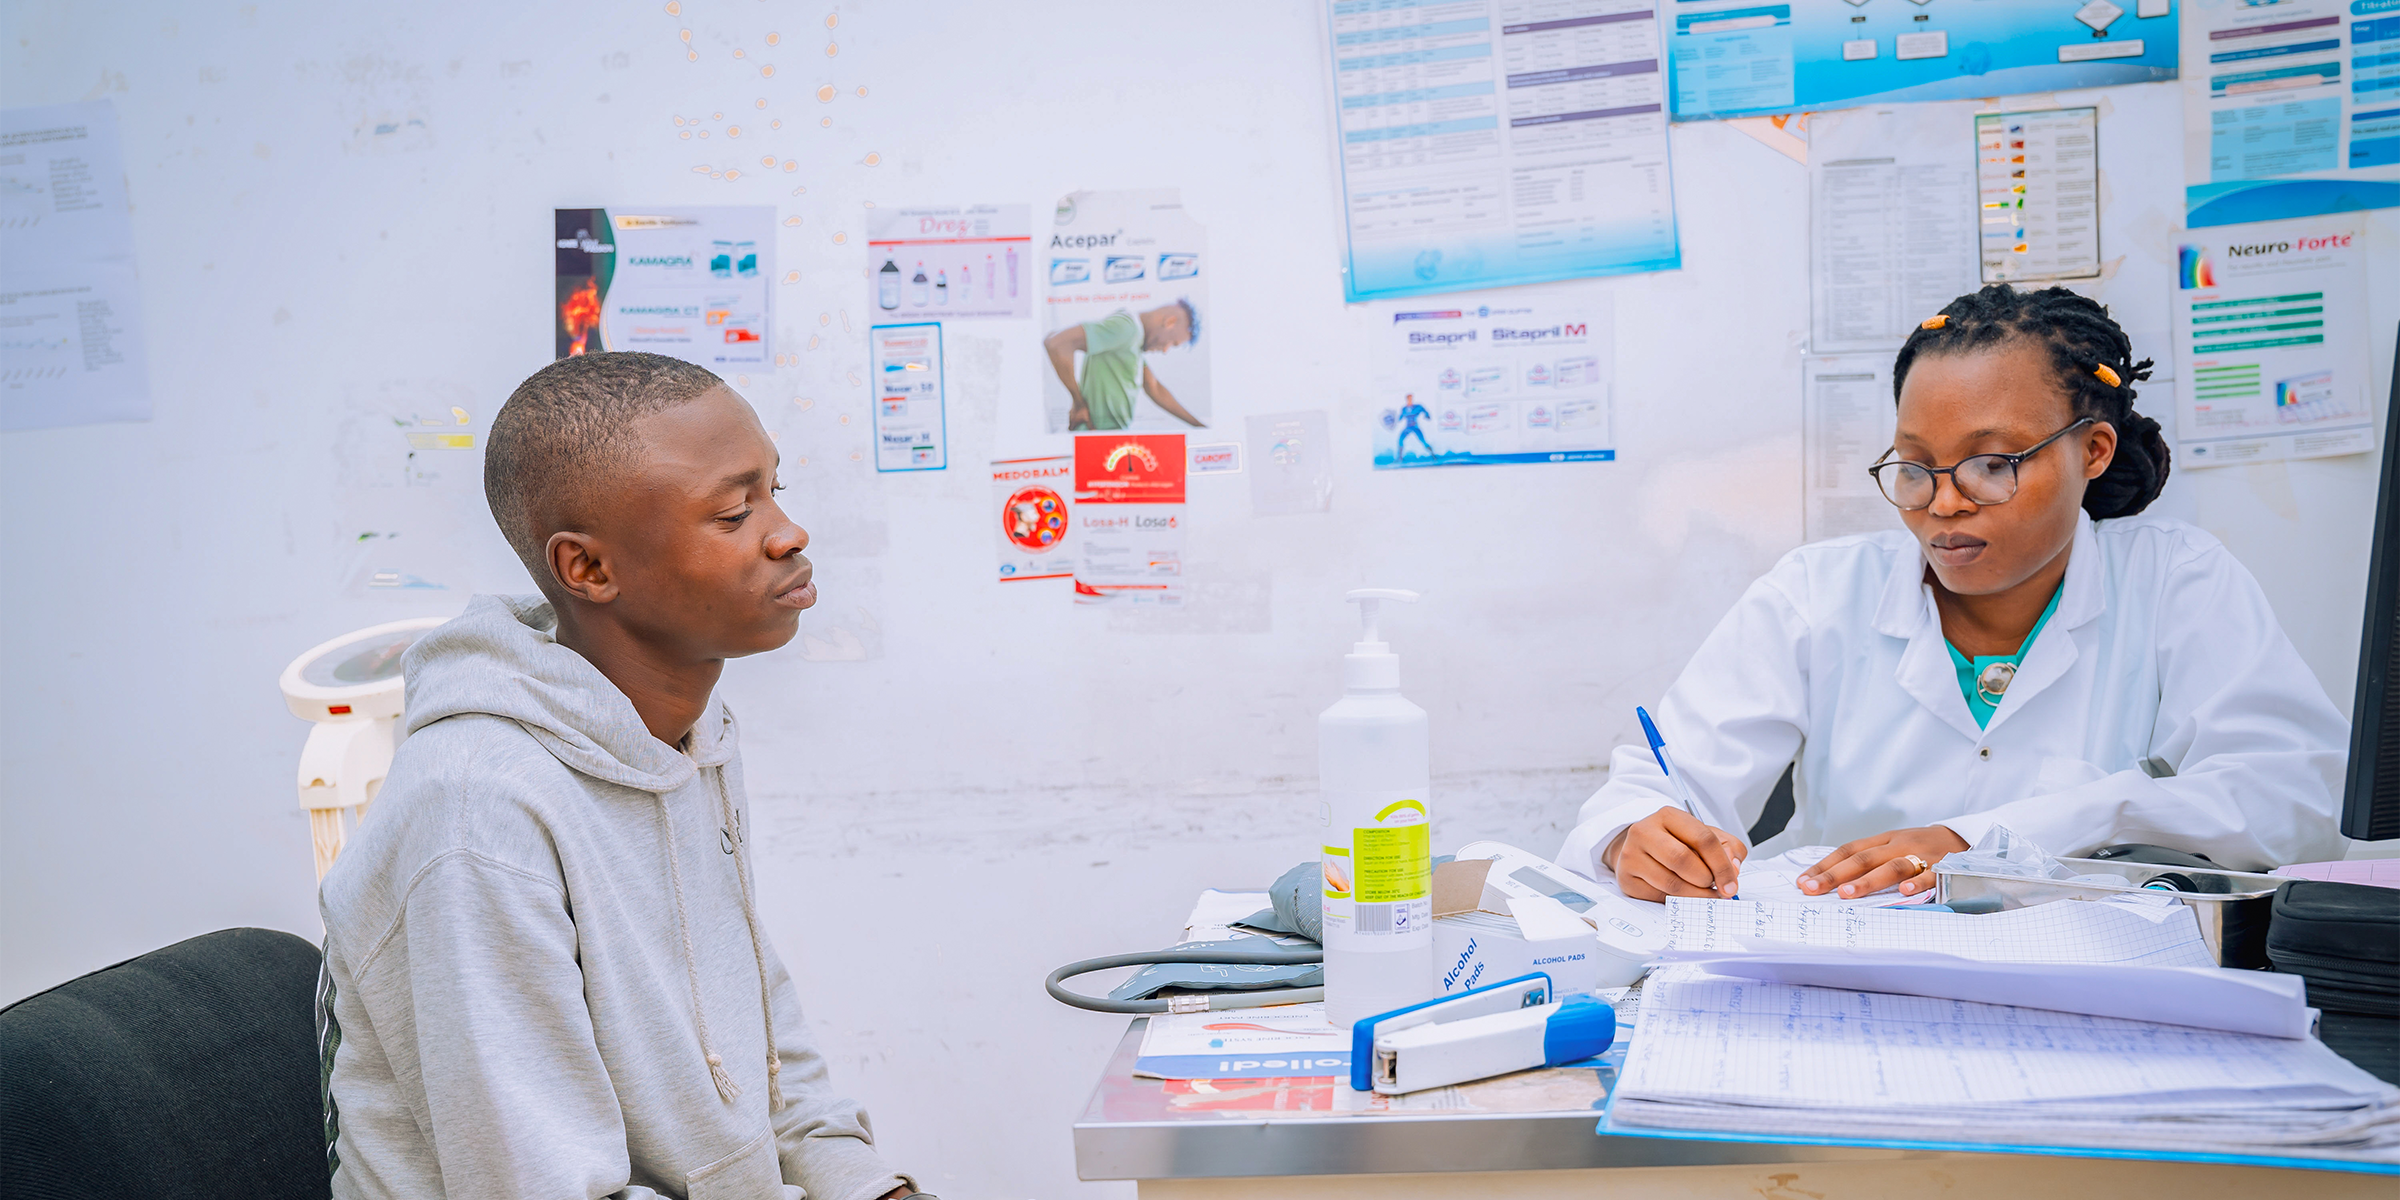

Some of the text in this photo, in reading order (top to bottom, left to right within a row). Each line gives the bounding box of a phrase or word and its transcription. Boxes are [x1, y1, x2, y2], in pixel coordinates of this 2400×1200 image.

[1050, 234, 1117, 250] Acepar
[2228, 234, 2351, 258] Neuro-Forte
[629, 256, 692, 266] KAMAGRA
[620, 306, 679, 315] KAMAGRA
[1409, 330, 1477, 345] Sitapril
[1492, 324, 1586, 342] Sitapril M
[993, 467, 1069, 481] MEDOBALM
[1442, 938, 1478, 991] Alcohol
[1532, 954, 1585, 966] ALCOHOL PADS
[1464, 960, 1485, 991] Pads
